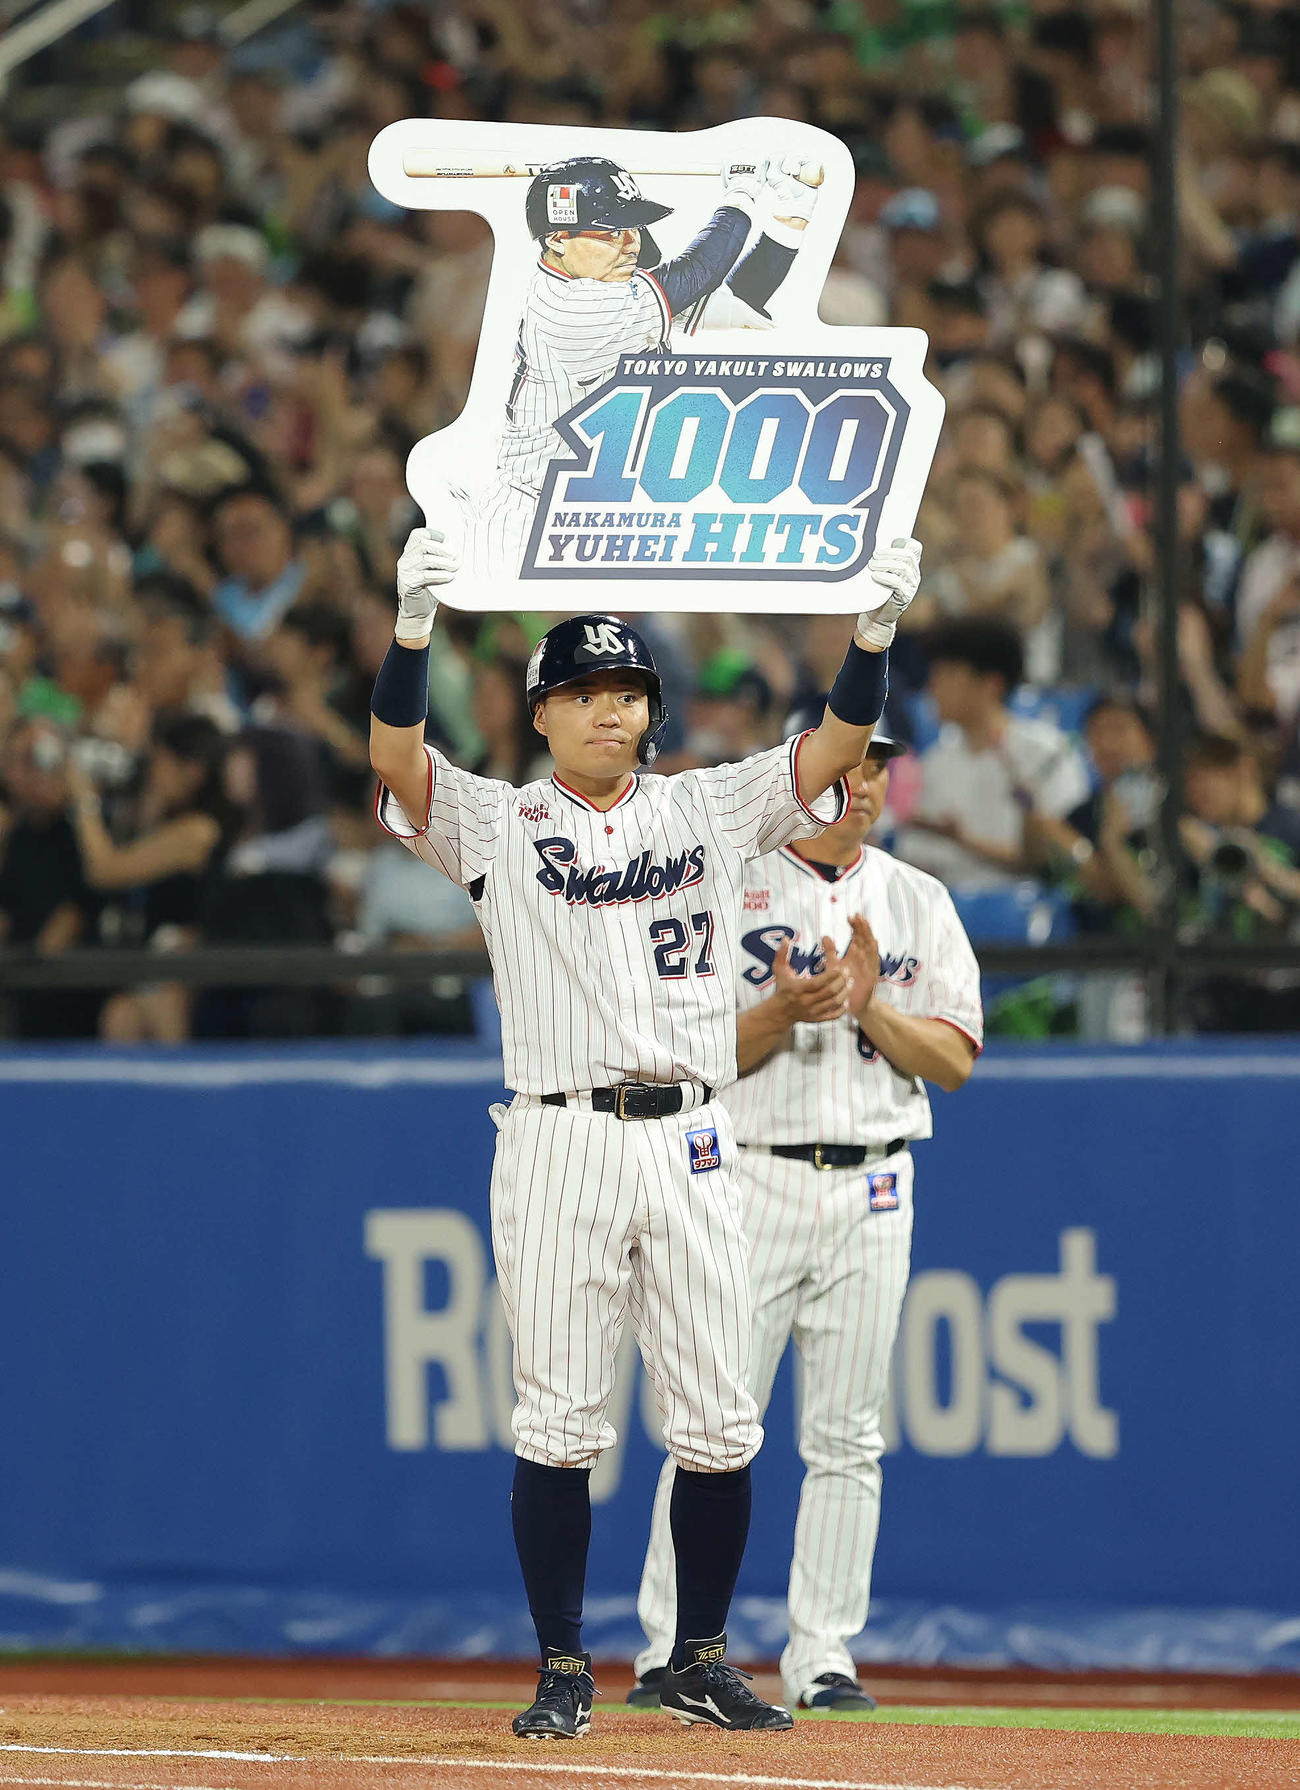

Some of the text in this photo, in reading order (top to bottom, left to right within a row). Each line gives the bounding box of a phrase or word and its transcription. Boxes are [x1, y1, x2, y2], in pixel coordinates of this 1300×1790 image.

[623, 359, 884, 379] TOKYO YAKULT SWALLOWS
[562, 392, 890, 505] 1000
[551, 512, 682, 529] NAKAMURA
[548, 534, 678, 562] YUHEI
[682, 513, 861, 565] HITS
[533, 837, 705, 909] Swallows
[649, 910, 715, 980] 27
[694, 1157, 718, 1168] タフマン
[795, 1227, 1122, 1459] ost
[551, 1661, 583, 1674] ZETT
[698, 1647, 725, 1662] ZETT
